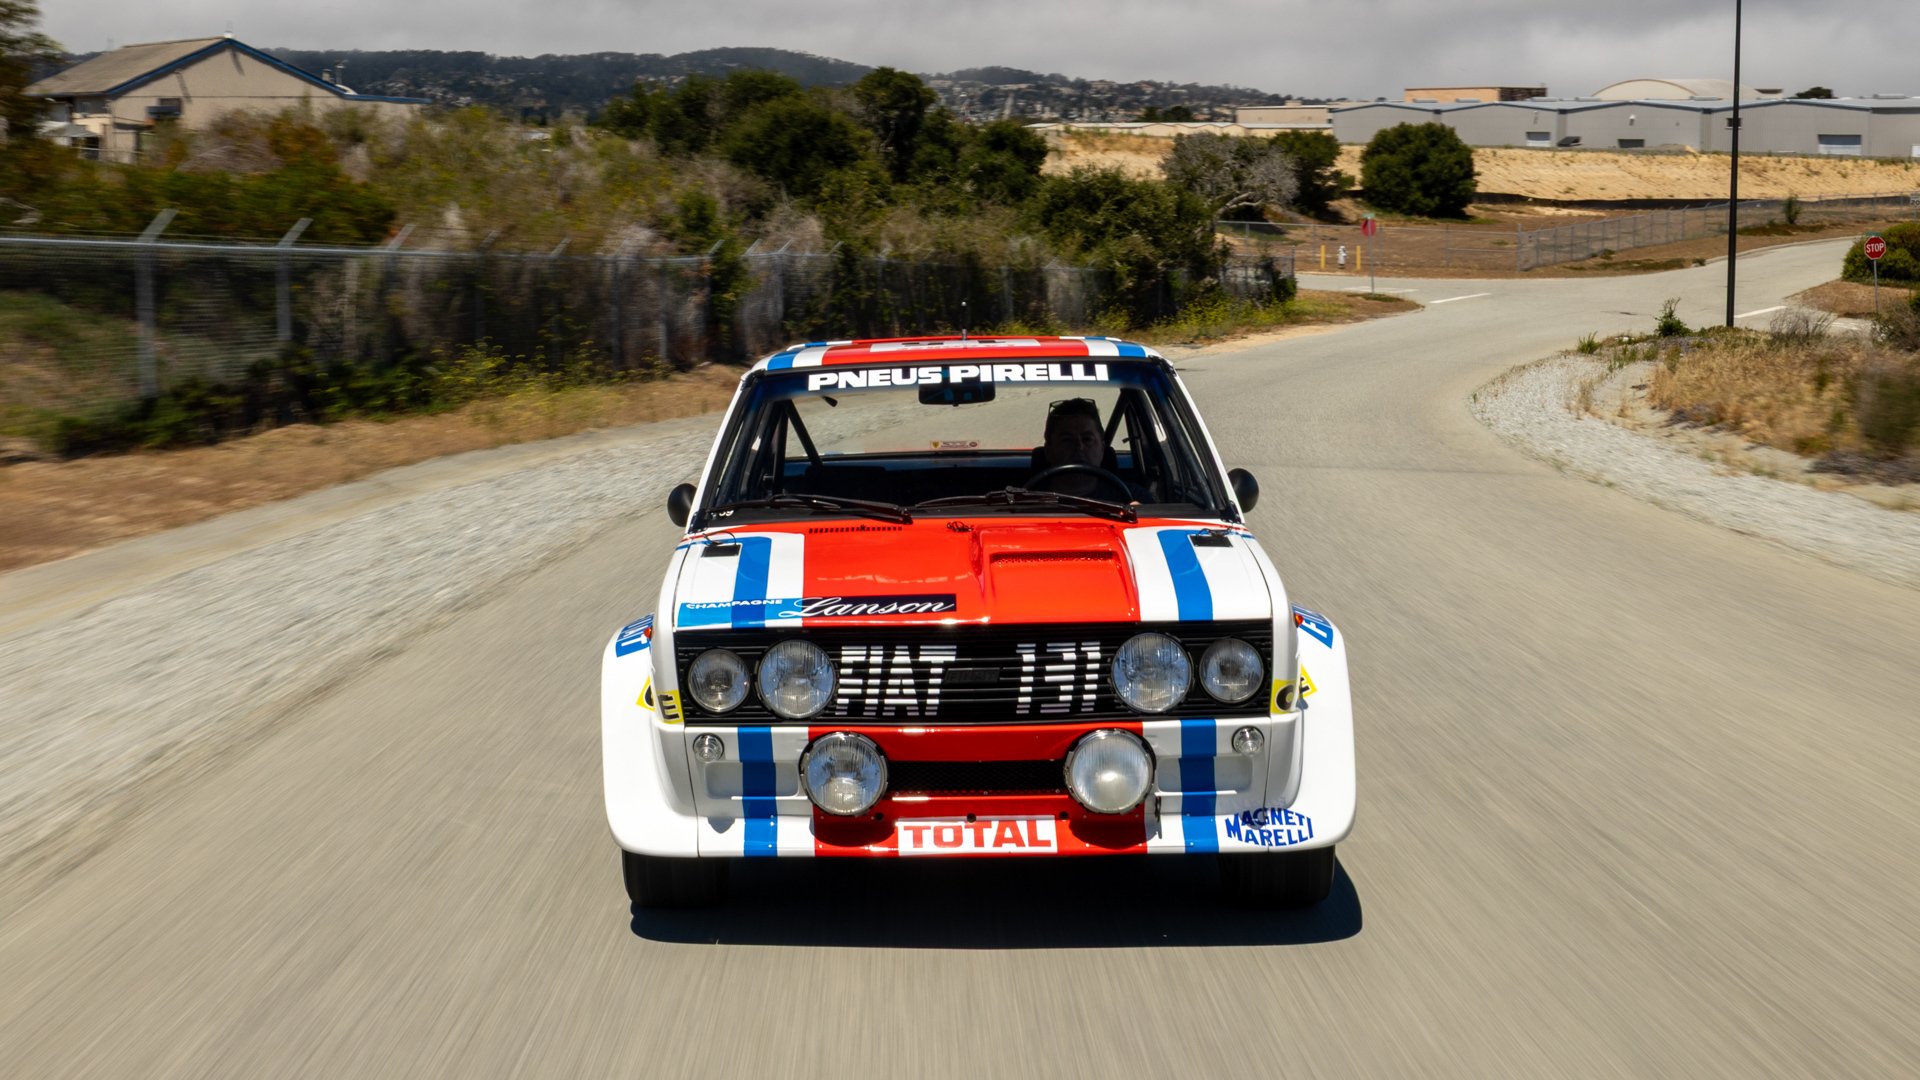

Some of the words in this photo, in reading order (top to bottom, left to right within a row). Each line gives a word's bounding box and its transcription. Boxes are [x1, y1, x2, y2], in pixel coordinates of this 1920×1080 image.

[1866, 242, 1885, 253] STOP
[808, 366, 943, 392] PNEUS
[949, 363, 1109, 384] PIRELLI
[686, 599, 783, 610] CHAMPAGNE
[778, 597, 956, 618] Lanson
[835, 645, 957, 716] FIAT
[1016, 642, 1101, 714] 131
[903, 819, 1052, 849] TOTAL
[1224, 807, 1314, 838] MAGNETI
[1224, 817, 1314, 847] MARELLI
